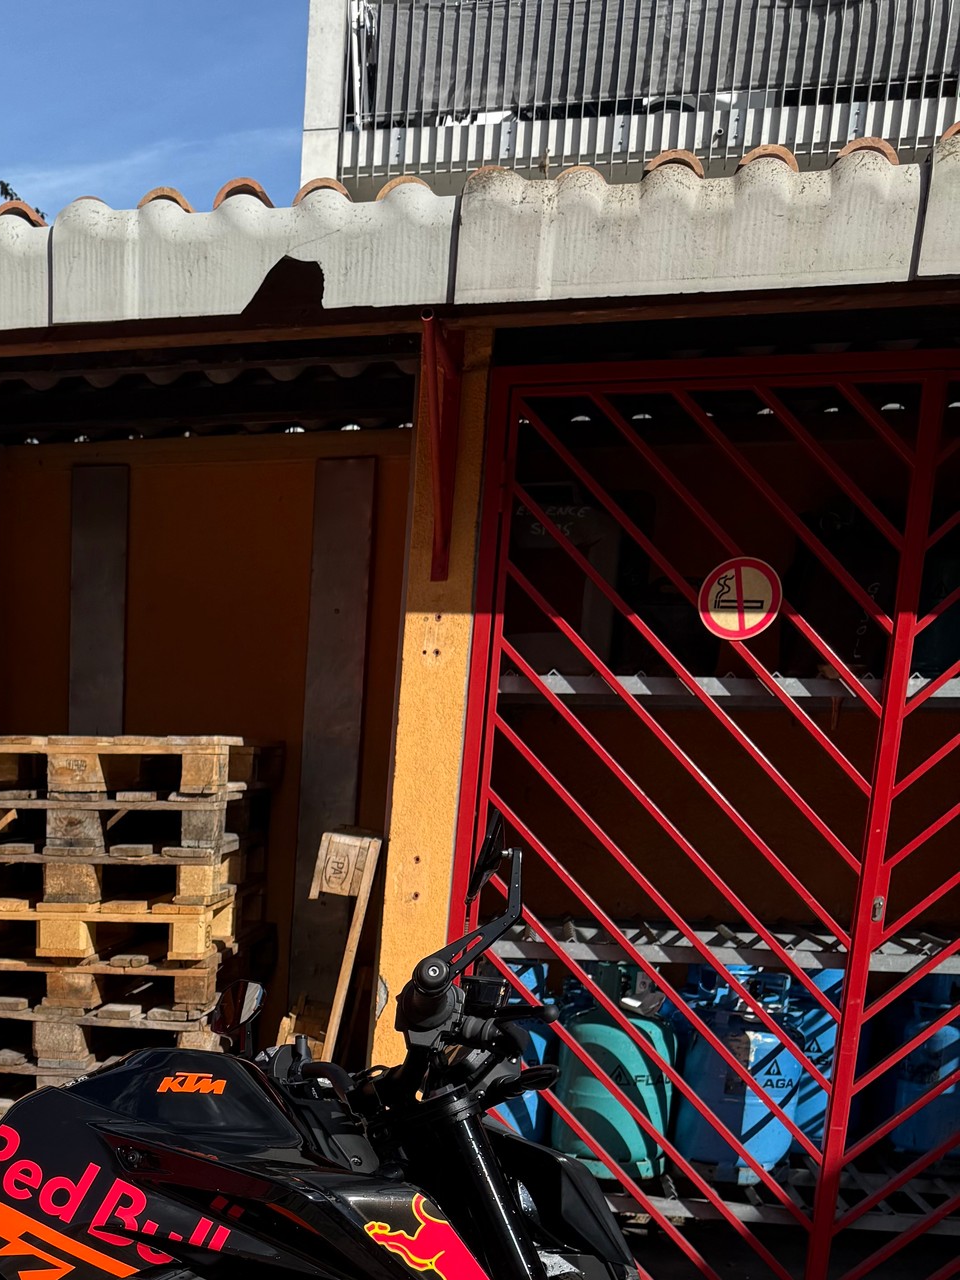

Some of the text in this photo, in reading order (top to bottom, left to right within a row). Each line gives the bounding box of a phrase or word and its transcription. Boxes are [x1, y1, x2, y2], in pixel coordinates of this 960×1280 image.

[515, 505, 592, 518] EENCE
[853, 582, 880, 659] GOIL
[327, 853, 347, 883] PAL
[156, 1072, 227, 1095] KTM
[634, 1074, 672, 1087] FLA
